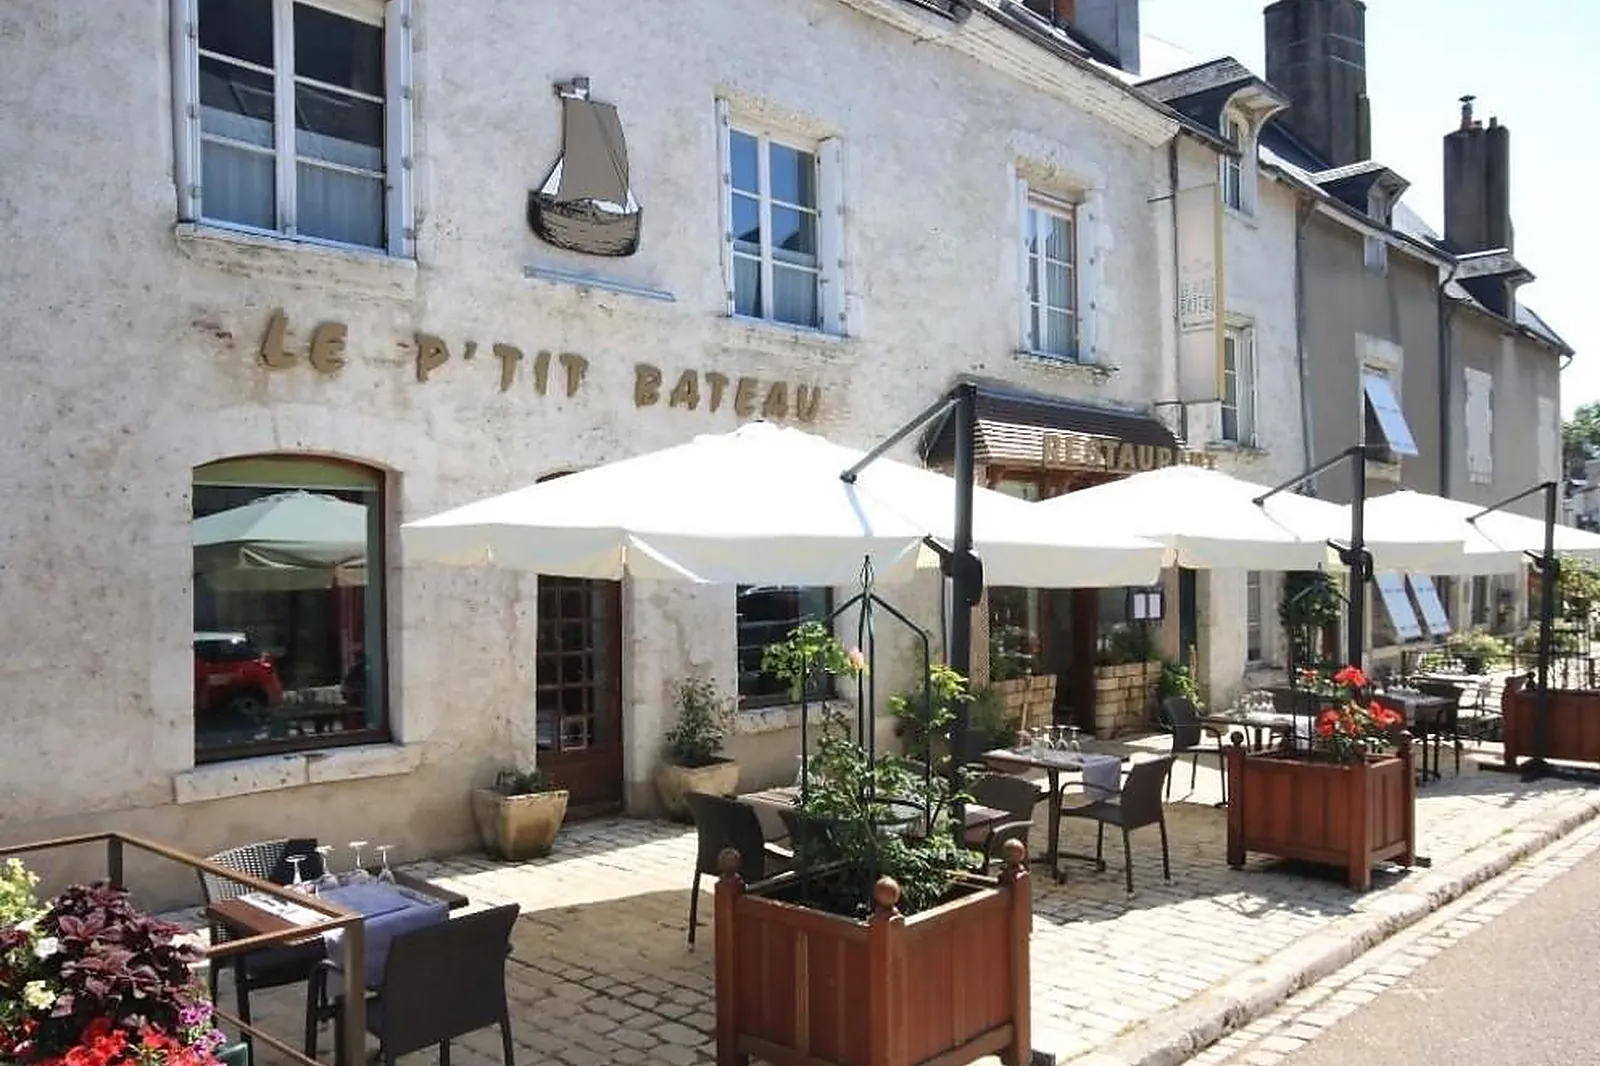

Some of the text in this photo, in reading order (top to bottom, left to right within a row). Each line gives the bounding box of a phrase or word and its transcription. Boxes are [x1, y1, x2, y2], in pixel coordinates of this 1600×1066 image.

[258, 309, 821, 423] LE P'TIT BATEAU
